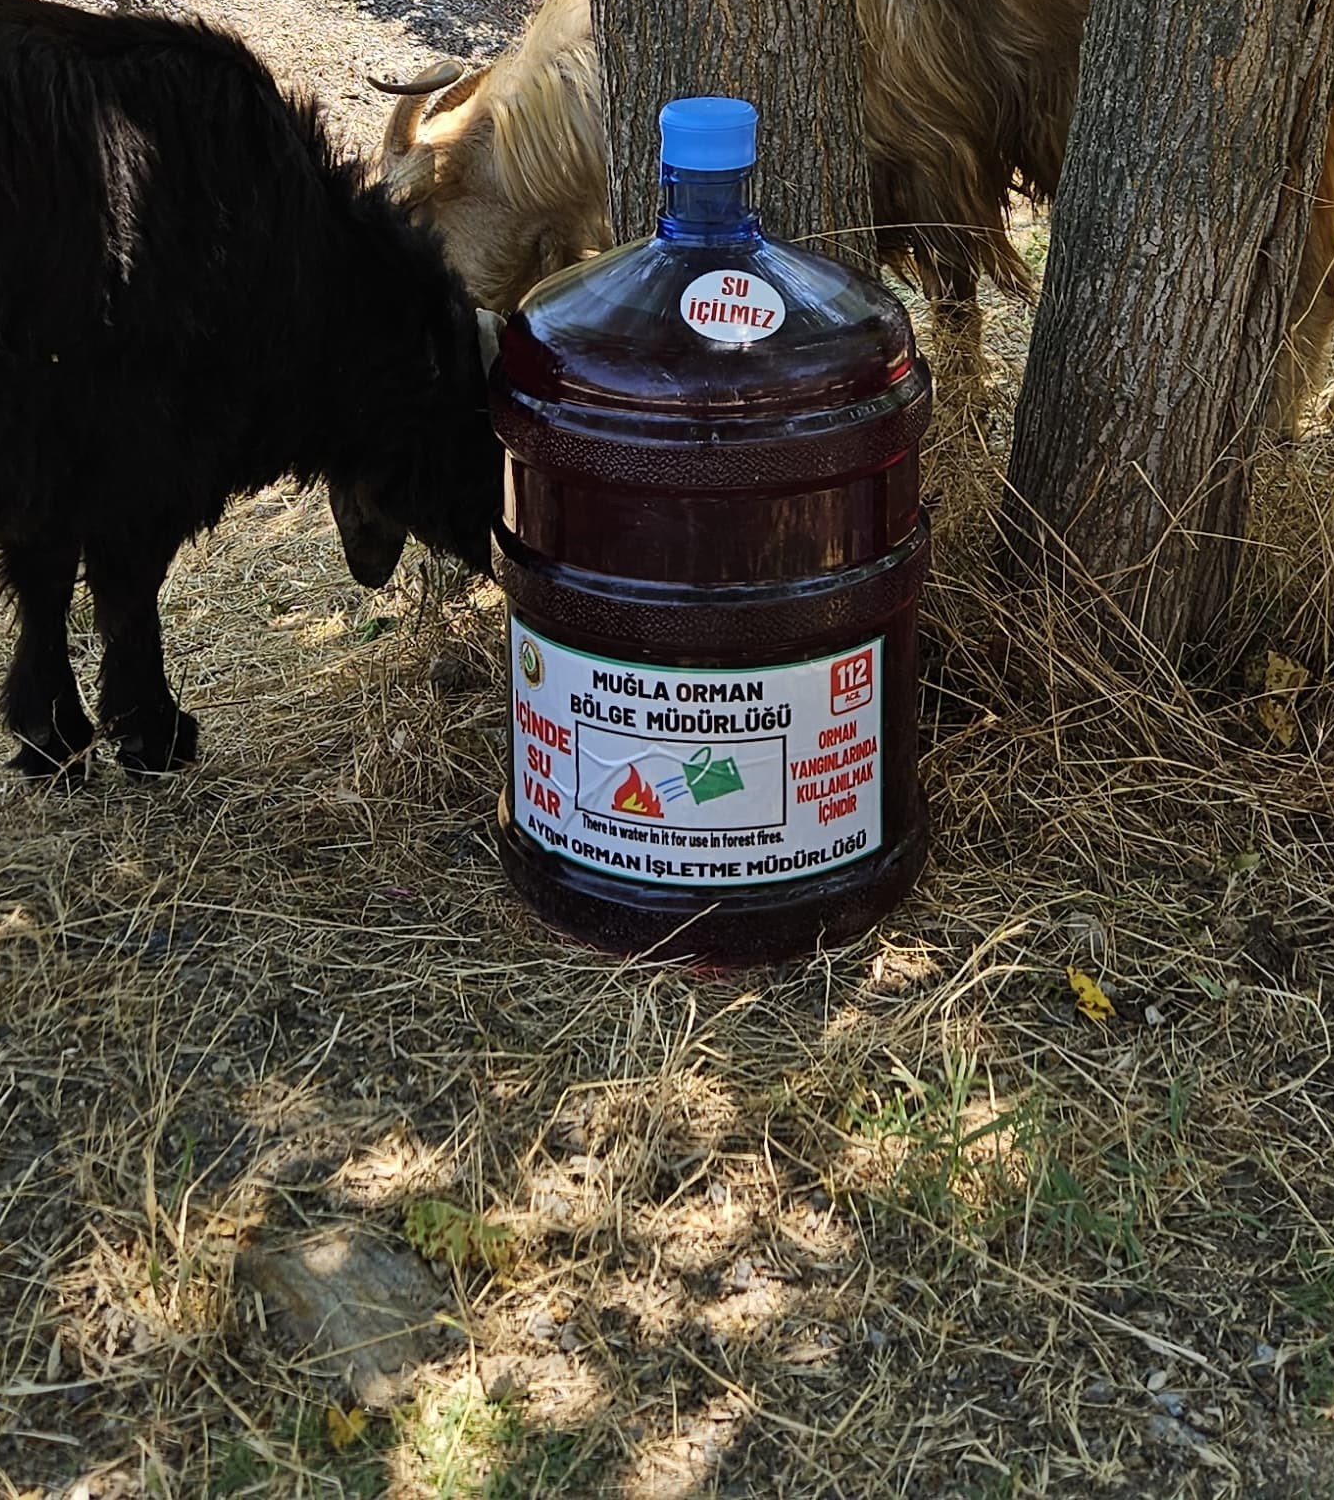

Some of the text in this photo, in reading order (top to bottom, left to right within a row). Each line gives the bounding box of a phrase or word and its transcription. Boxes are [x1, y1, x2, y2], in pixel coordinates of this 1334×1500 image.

[722, 276, 749, 297] SU
[689, 298, 776, 329] İÇİLMEZ
[592, 669, 764, 703] MUĞLA ORMAN
[838, 658, 867, 690] 112
[516, 688, 572, 755] İÇİNDE
[570, 693, 792, 734] BÖLGE MÜDÜRLÜĞÜ
[818, 720, 857, 749] ORMAN
[528, 743, 551, 779] SU
[790, 735, 877, 780] YANGINLARINDA
[523, 770, 561, 820] VAR
[797, 761, 873, 804] KULLANILMAK
[819, 791, 857, 826] İÇİNDİR
[528, 813, 867, 878] AYDIN ORMAN İŞLETME MÜDÜRLÜĞÜ
[582, 813, 785, 848] There is water in it for use in forest fires.
